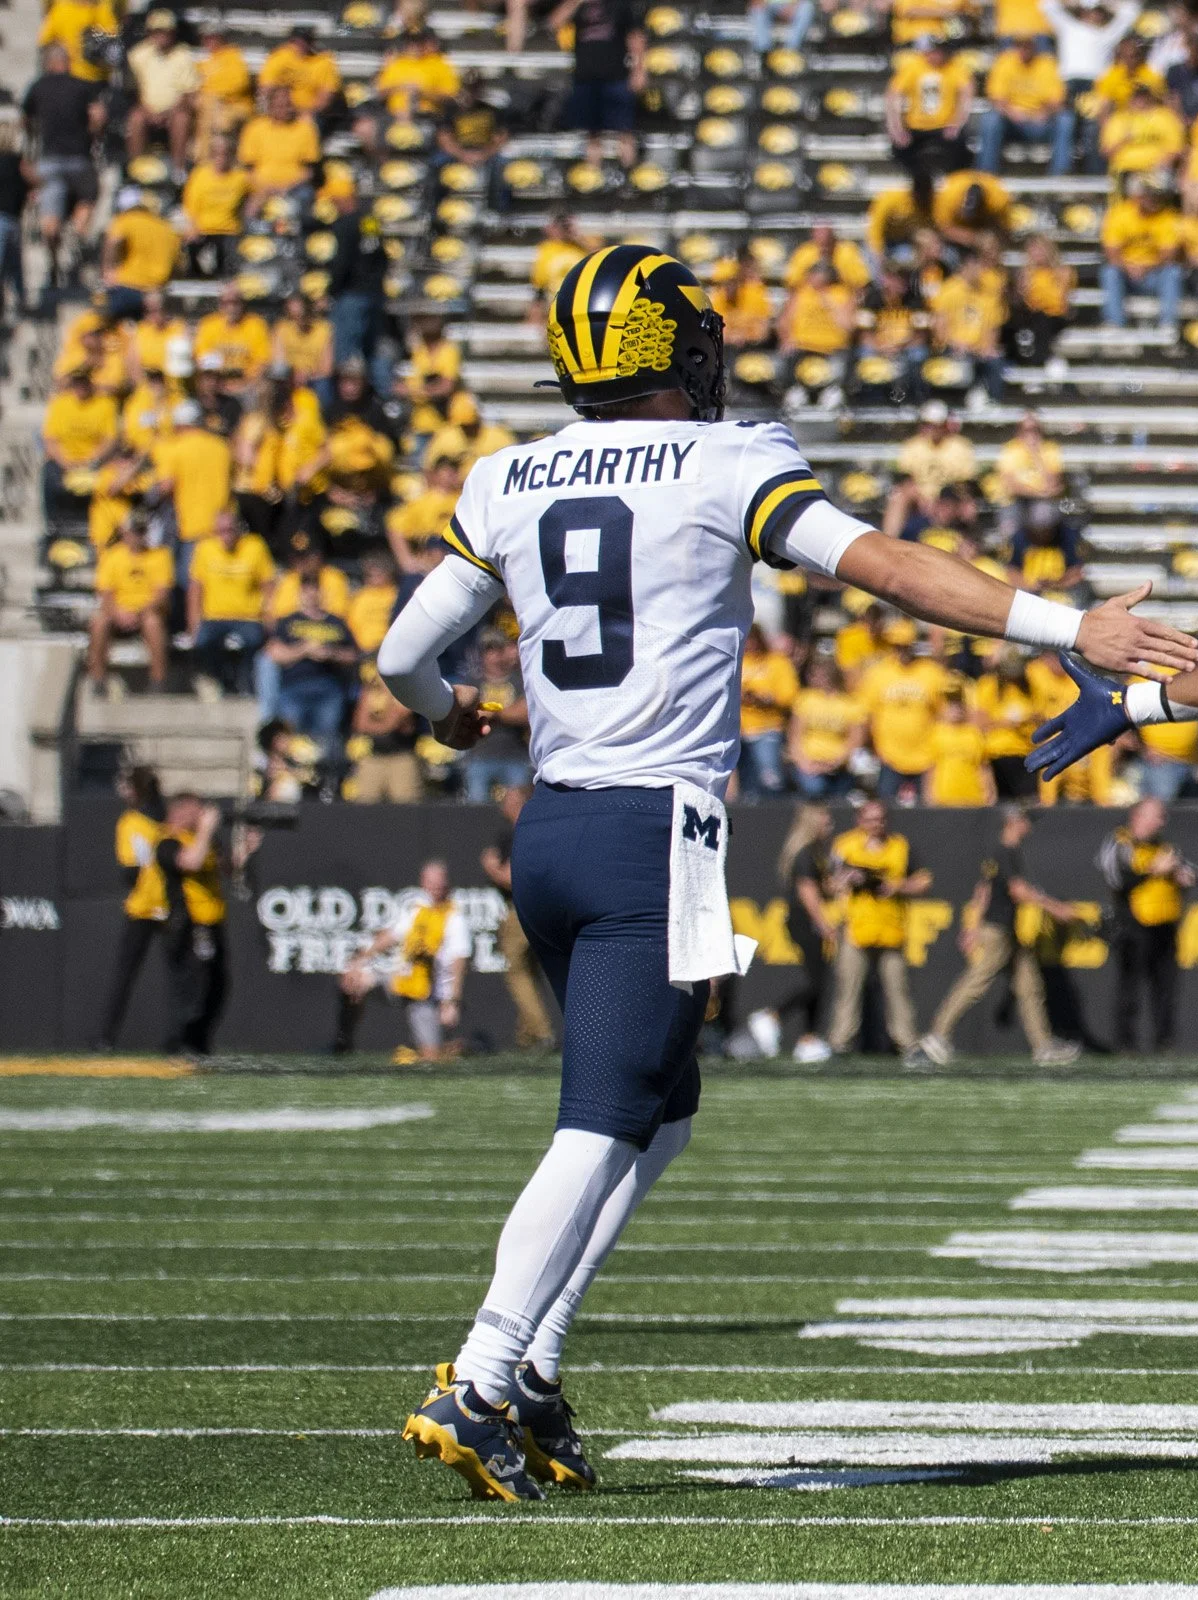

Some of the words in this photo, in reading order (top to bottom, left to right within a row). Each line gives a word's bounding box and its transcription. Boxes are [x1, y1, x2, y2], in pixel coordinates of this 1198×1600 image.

[502, 440, 698, 496] McCARTHY
[538, 495, 635, 692] 9
[683, 803, 721, 852] M
[257, 886, 357, 931] OLD
